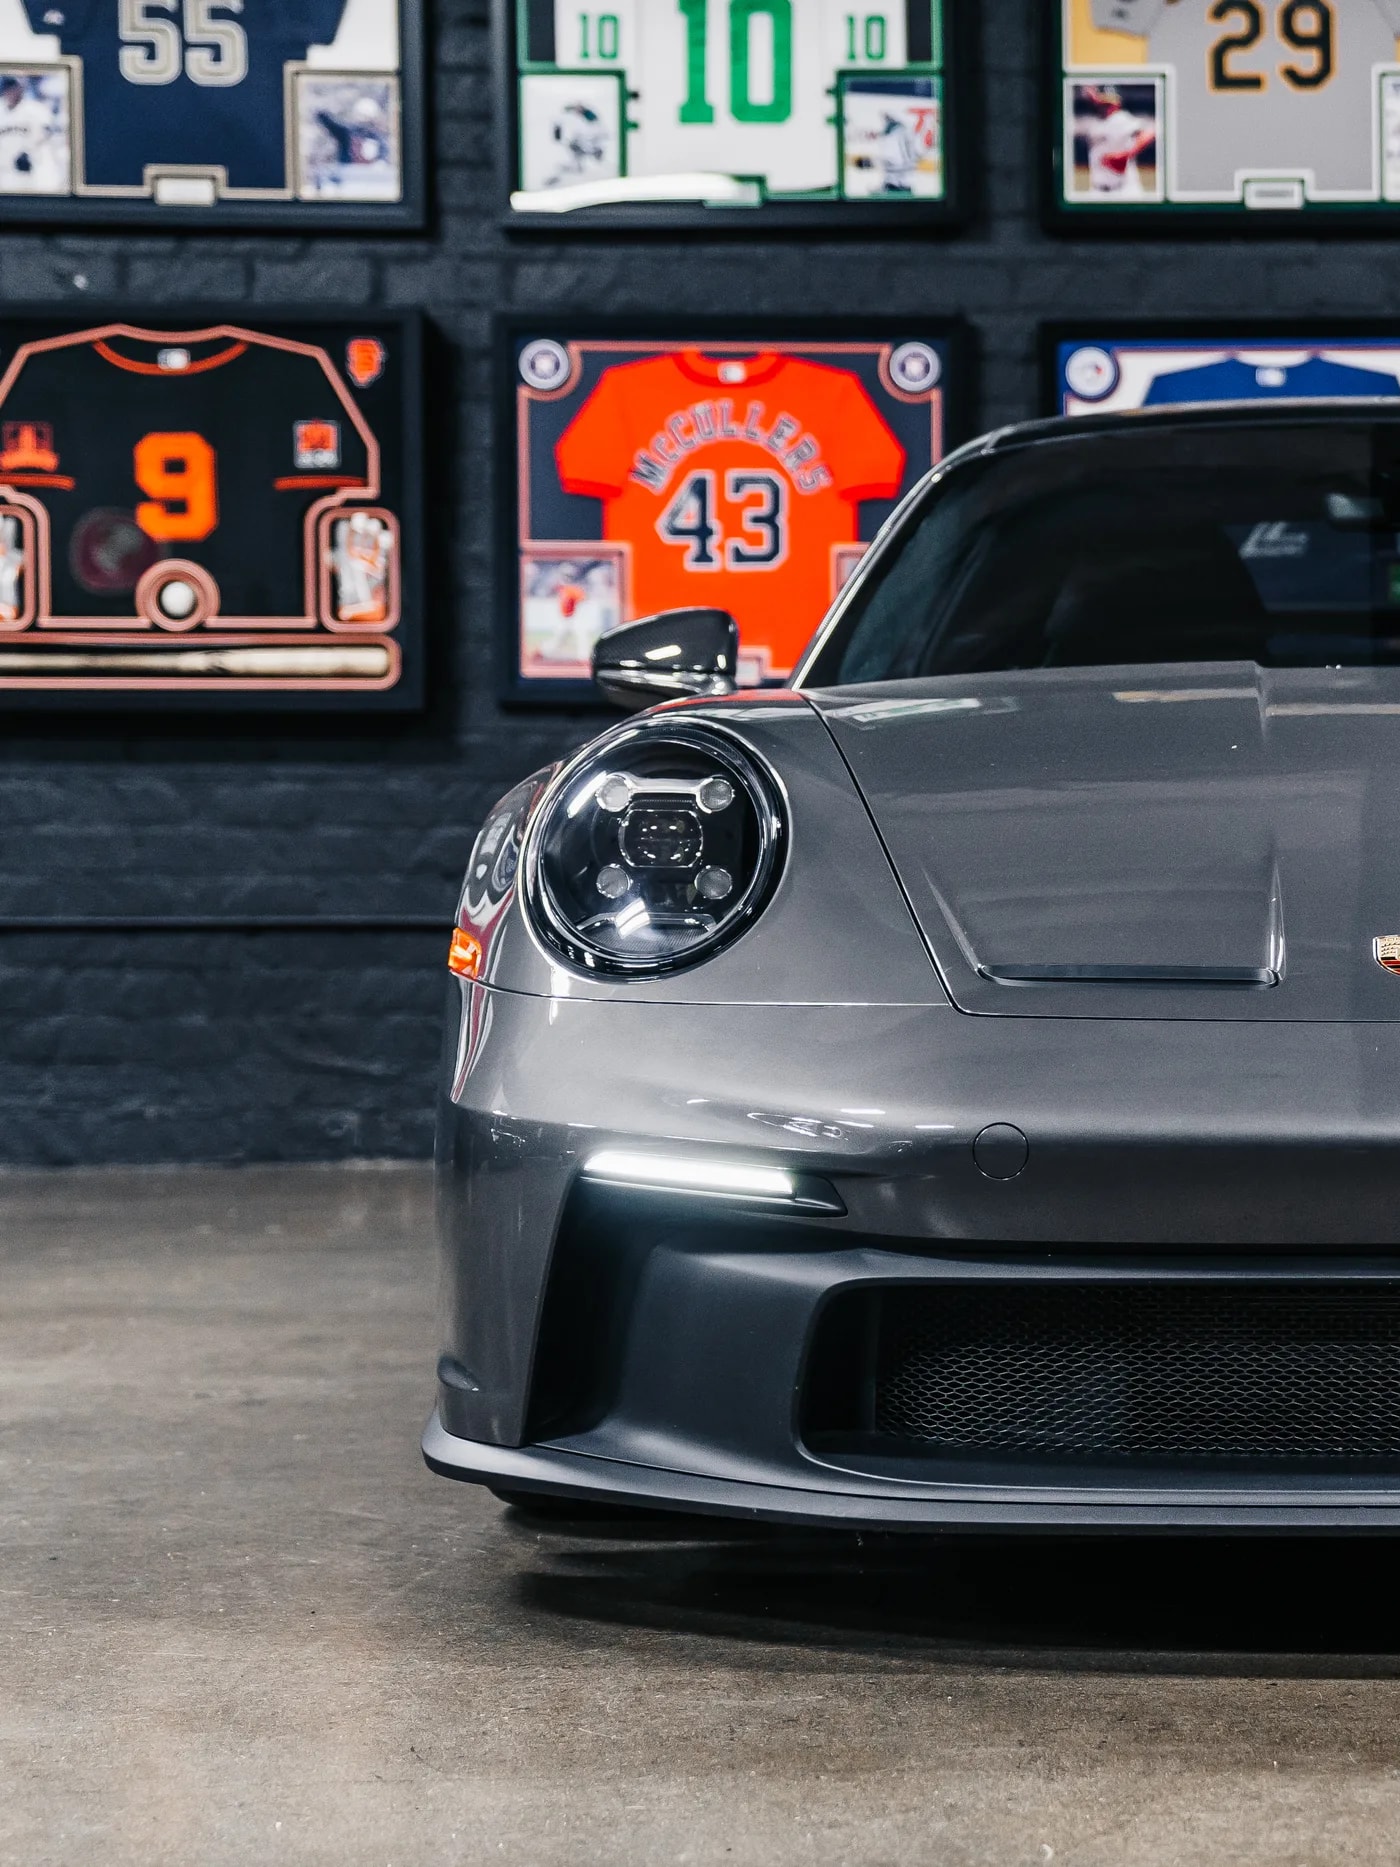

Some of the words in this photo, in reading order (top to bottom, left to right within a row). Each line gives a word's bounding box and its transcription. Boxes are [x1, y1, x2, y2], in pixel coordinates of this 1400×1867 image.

[117, 0, 248, 87] 55
[580, 14, 619, 60] 10
[678, 0, 792, 123] 10
[847, 15, 886, 60] 10
[1205, 0, 1339, 94] 29
[133, 431, 217, 542] 9
[655, 468, 788, 572] 43
